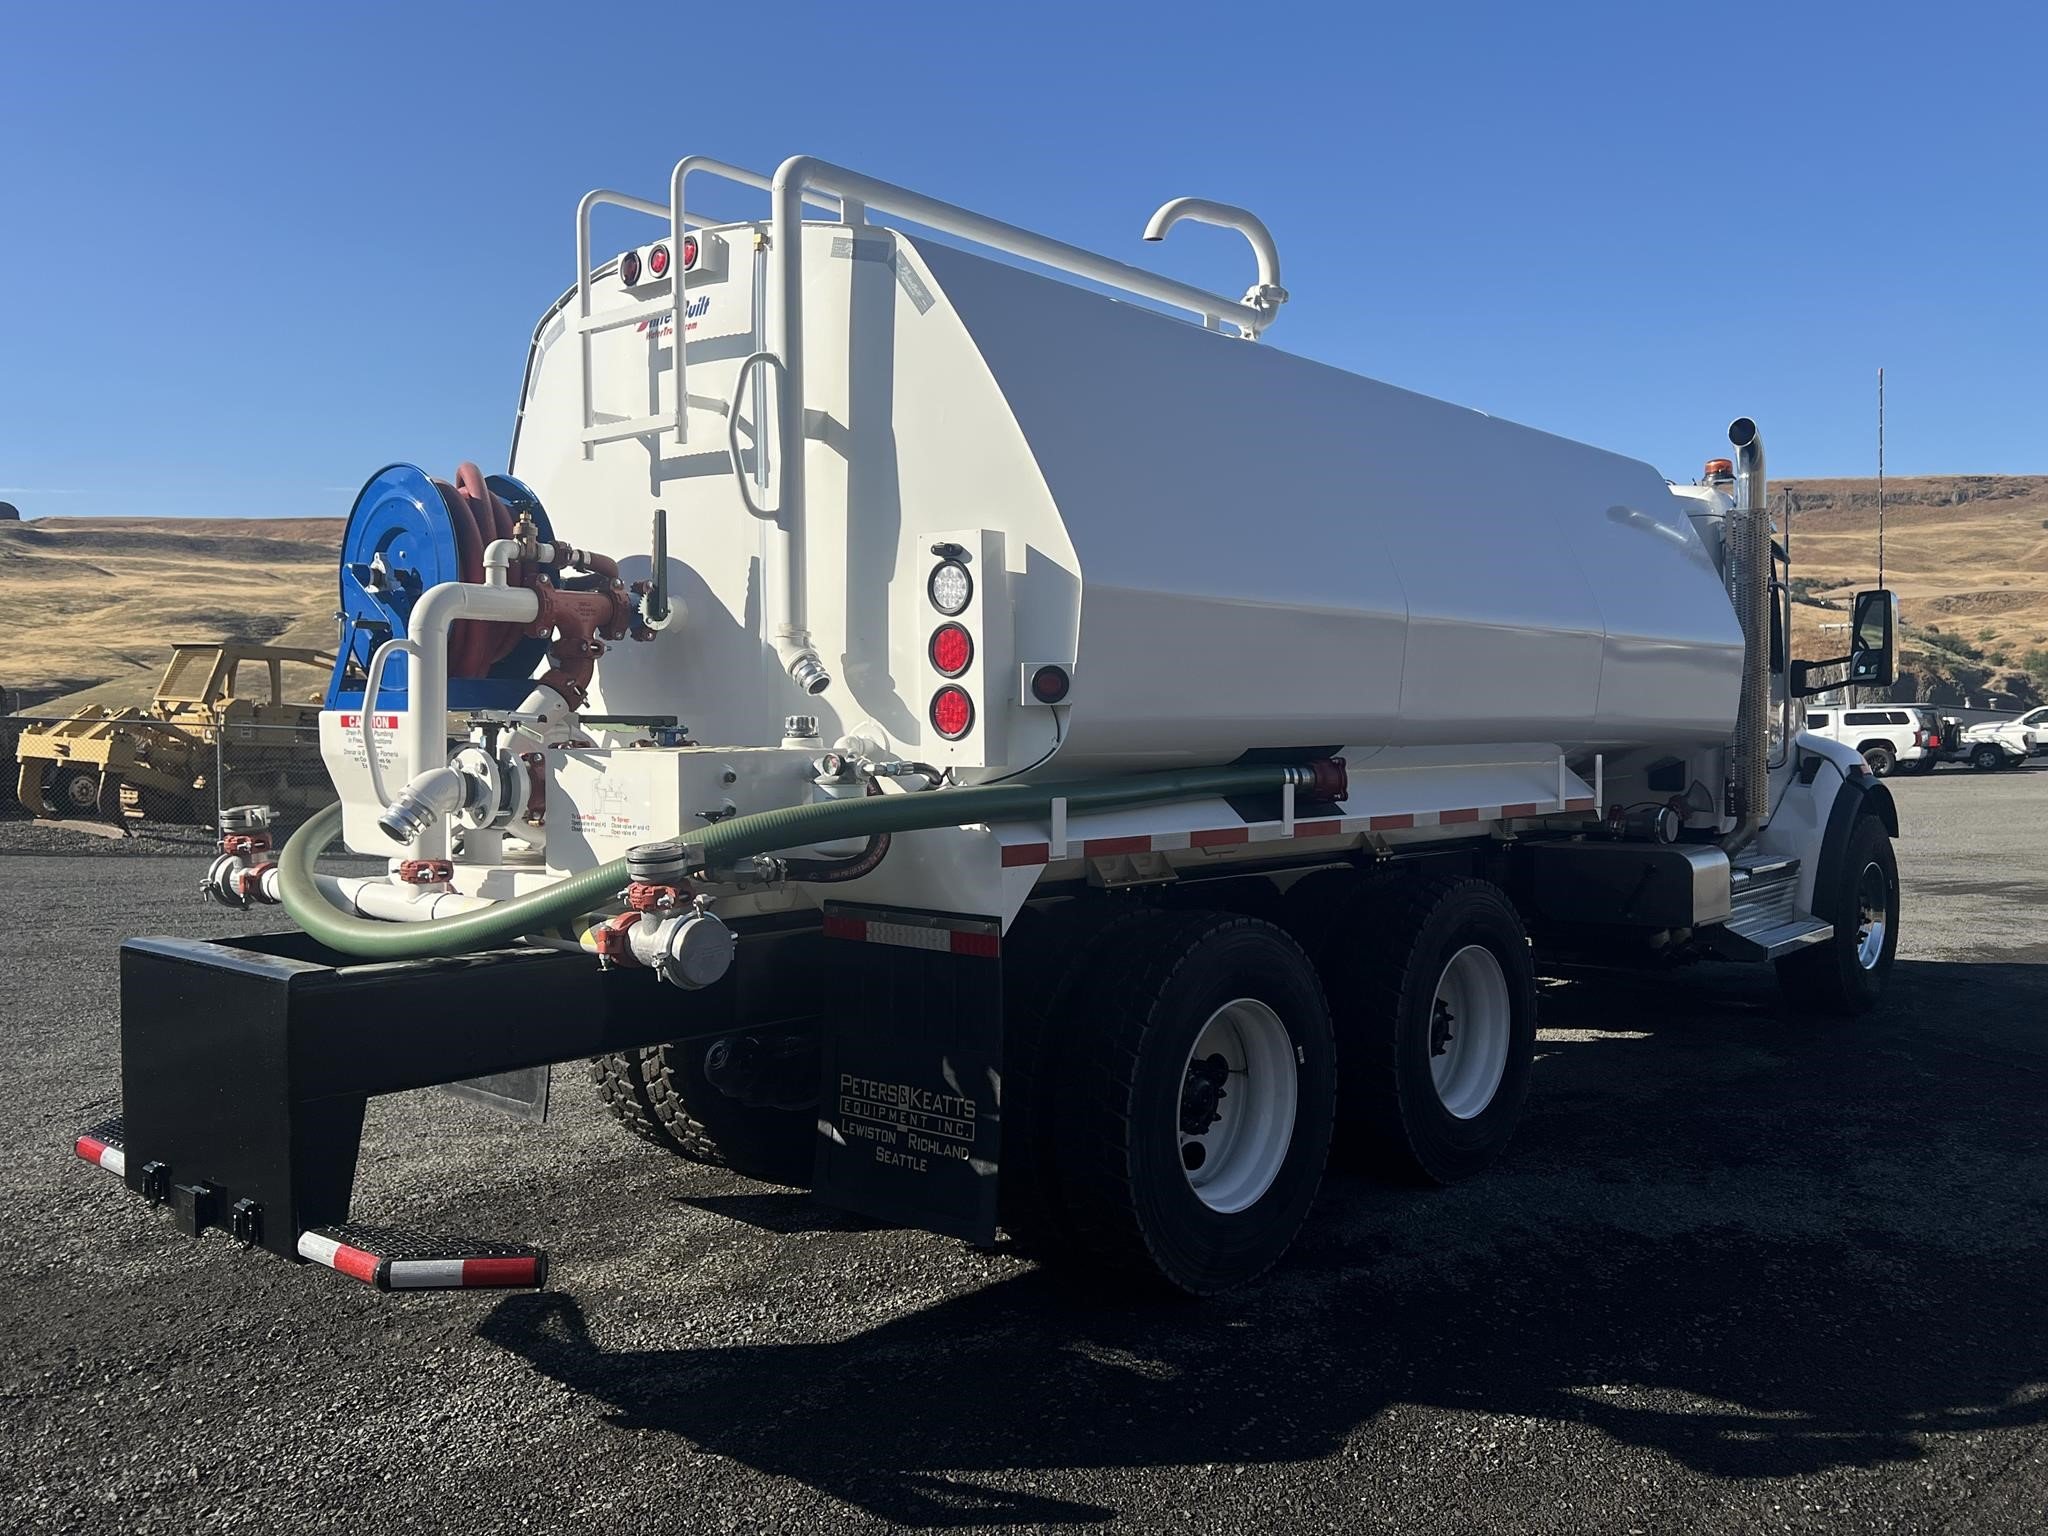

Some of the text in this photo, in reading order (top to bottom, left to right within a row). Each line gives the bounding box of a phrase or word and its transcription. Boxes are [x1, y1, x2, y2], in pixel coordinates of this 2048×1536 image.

[348, 716, 389, 728] CAION
[844, 1099, 970, 1137] EQUIPMENT INC.
[841, 1119, 970, 1161] LEWISTON RICHLAND
[875, 1146, 928, 1172] SEATTLE
